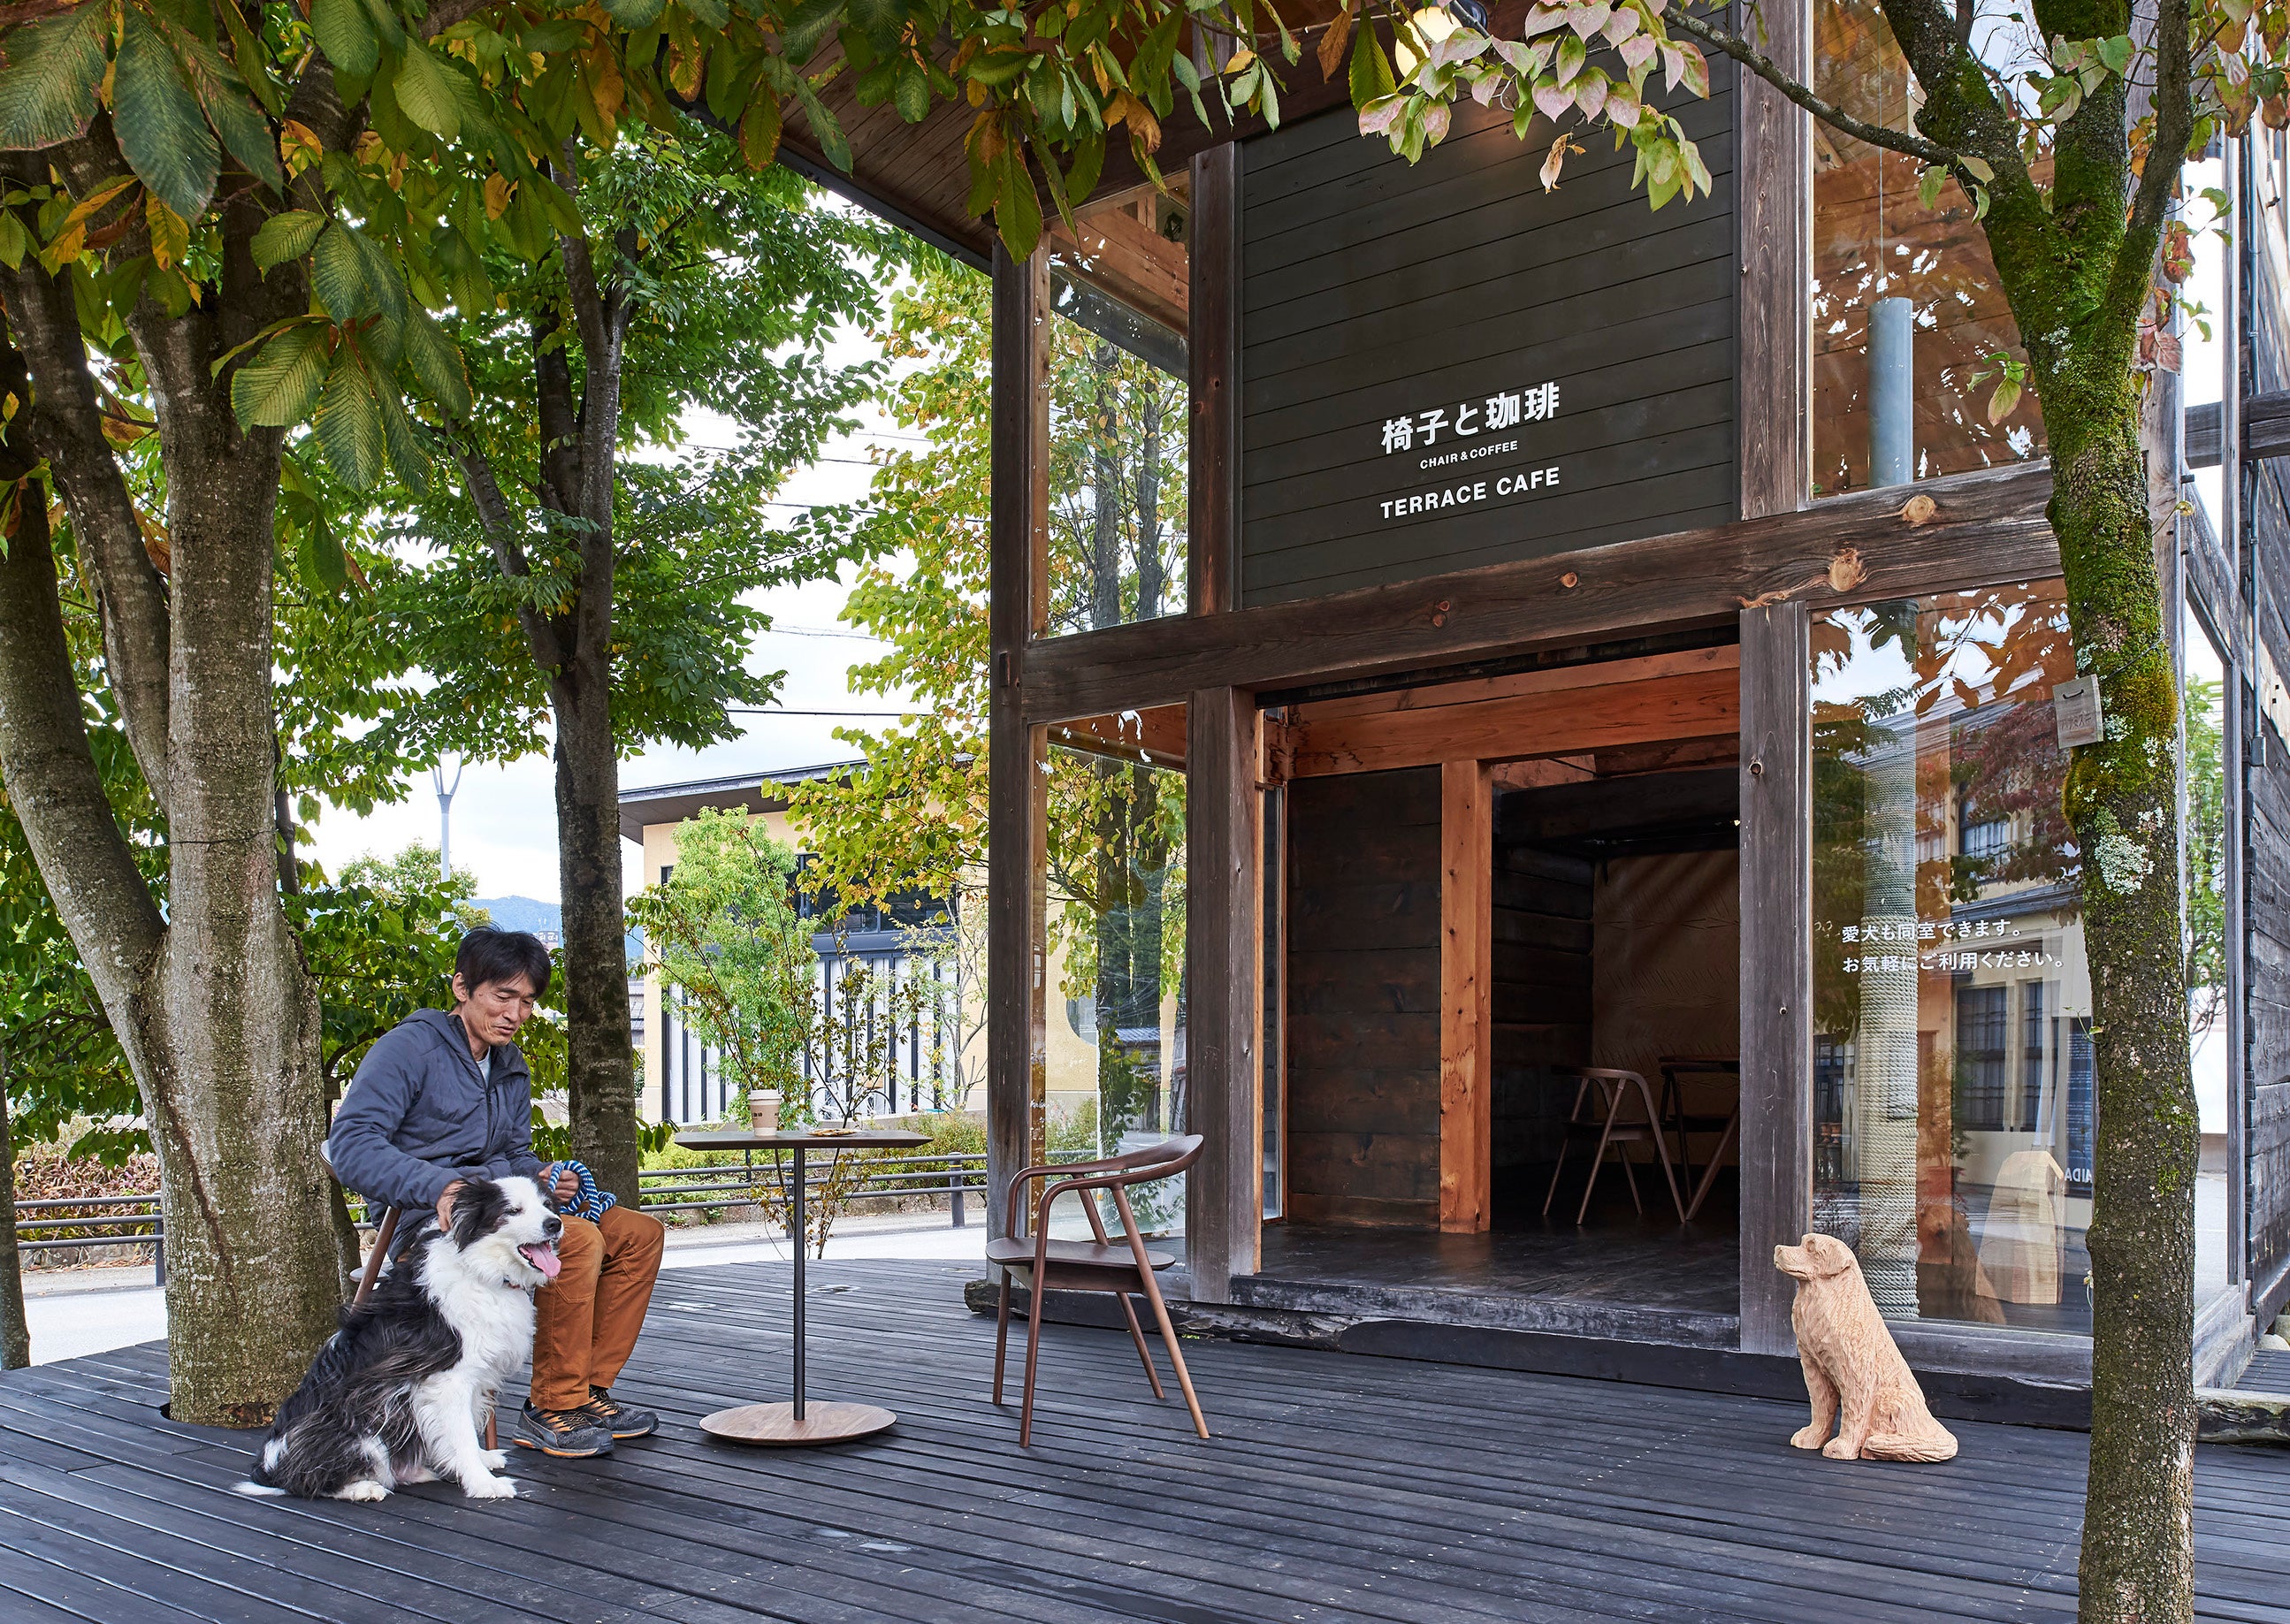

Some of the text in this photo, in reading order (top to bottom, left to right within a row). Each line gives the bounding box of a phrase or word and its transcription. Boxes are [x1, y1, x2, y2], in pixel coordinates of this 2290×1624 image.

[1381, 382, 1560, 454] 椅子と珈琲
[1380, 467, 1560, 519] TERRACE CAFE
[1842, 919, 2020, 943] 愛犬も同室できます。
[1842, 950, 2064, 973] お気軽にご利用ください。
